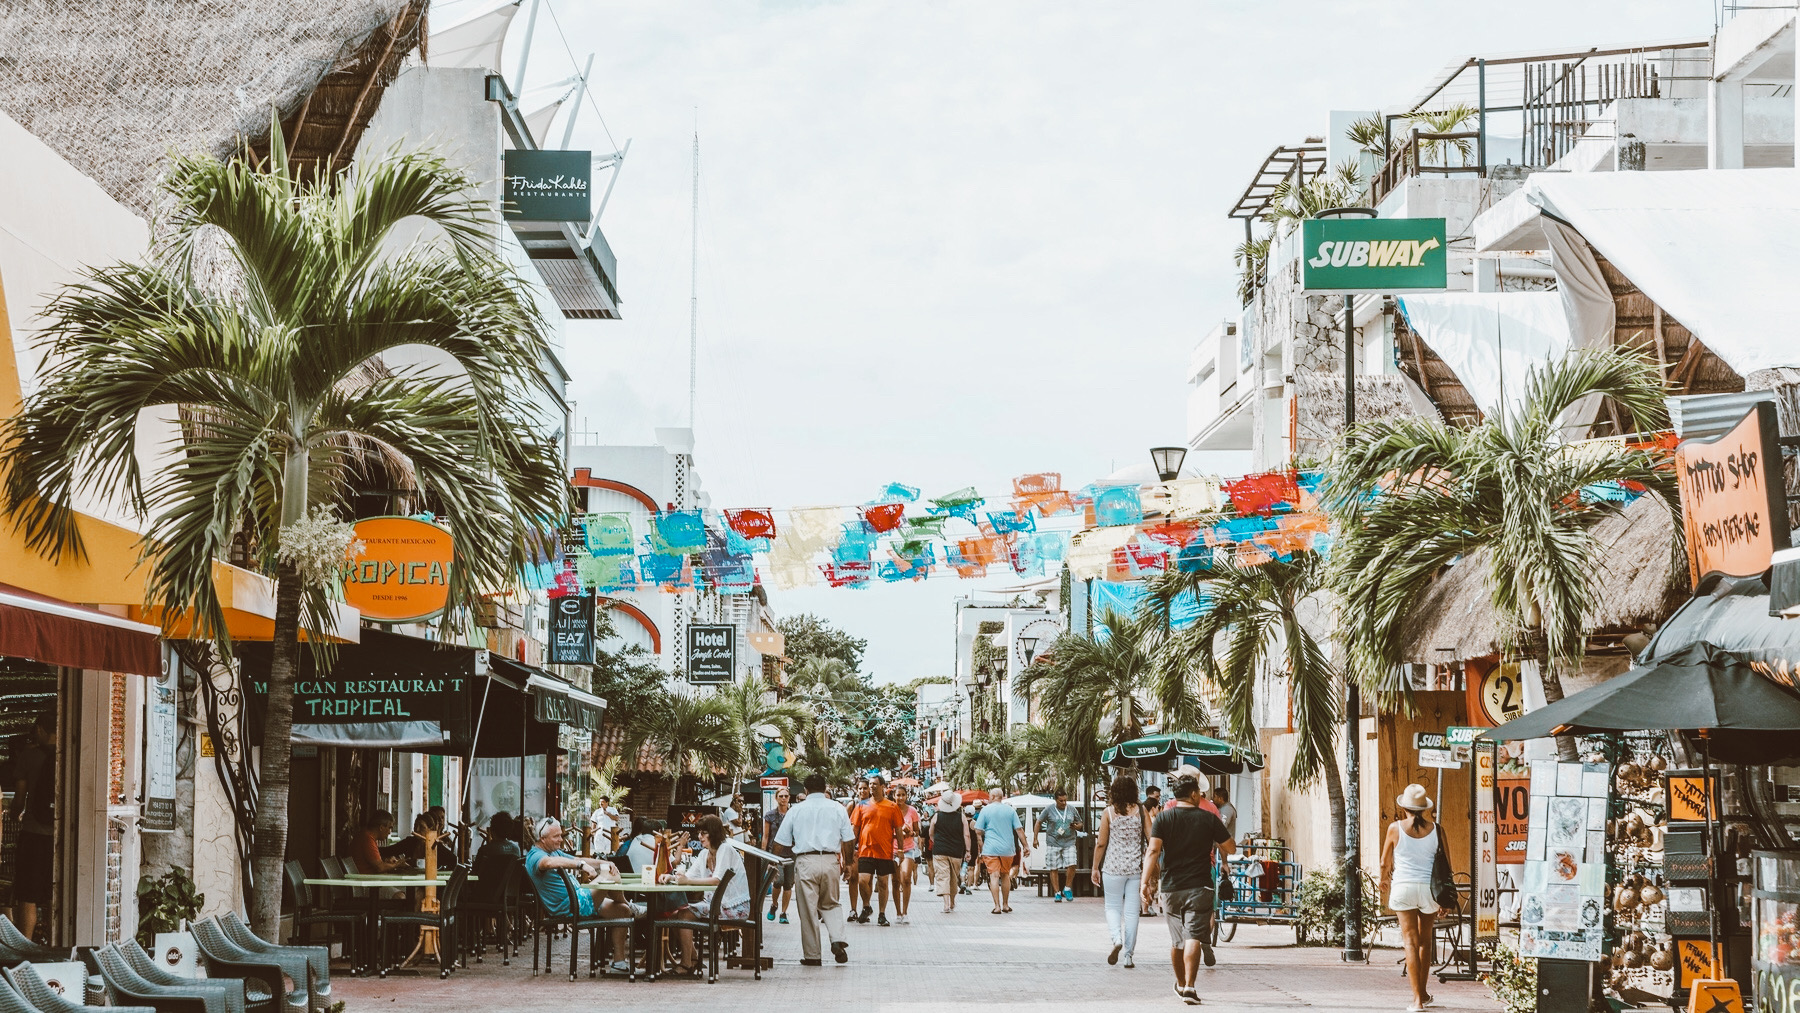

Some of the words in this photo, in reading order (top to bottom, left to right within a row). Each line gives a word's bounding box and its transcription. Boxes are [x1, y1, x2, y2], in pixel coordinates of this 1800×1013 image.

[511, 175, 552, 190] Frida
[1308, 237, 1440, 269] SUBWAY
[1687, 456, 1725, 508] TATTOO
[1728, 443, 1758, 496] SHOP
[341, 559, 453, 585] ROPICA
[557, 632, 585, 643] EA7
[695, 631, 727, 646] Hotel
[254, 681, 337, 694] MICAN
[305, 698, 410, 716] TROPICAL
[1673, 784, 1707, 819] TEMPORA
[1505, 841, 1527, 851] SUB
